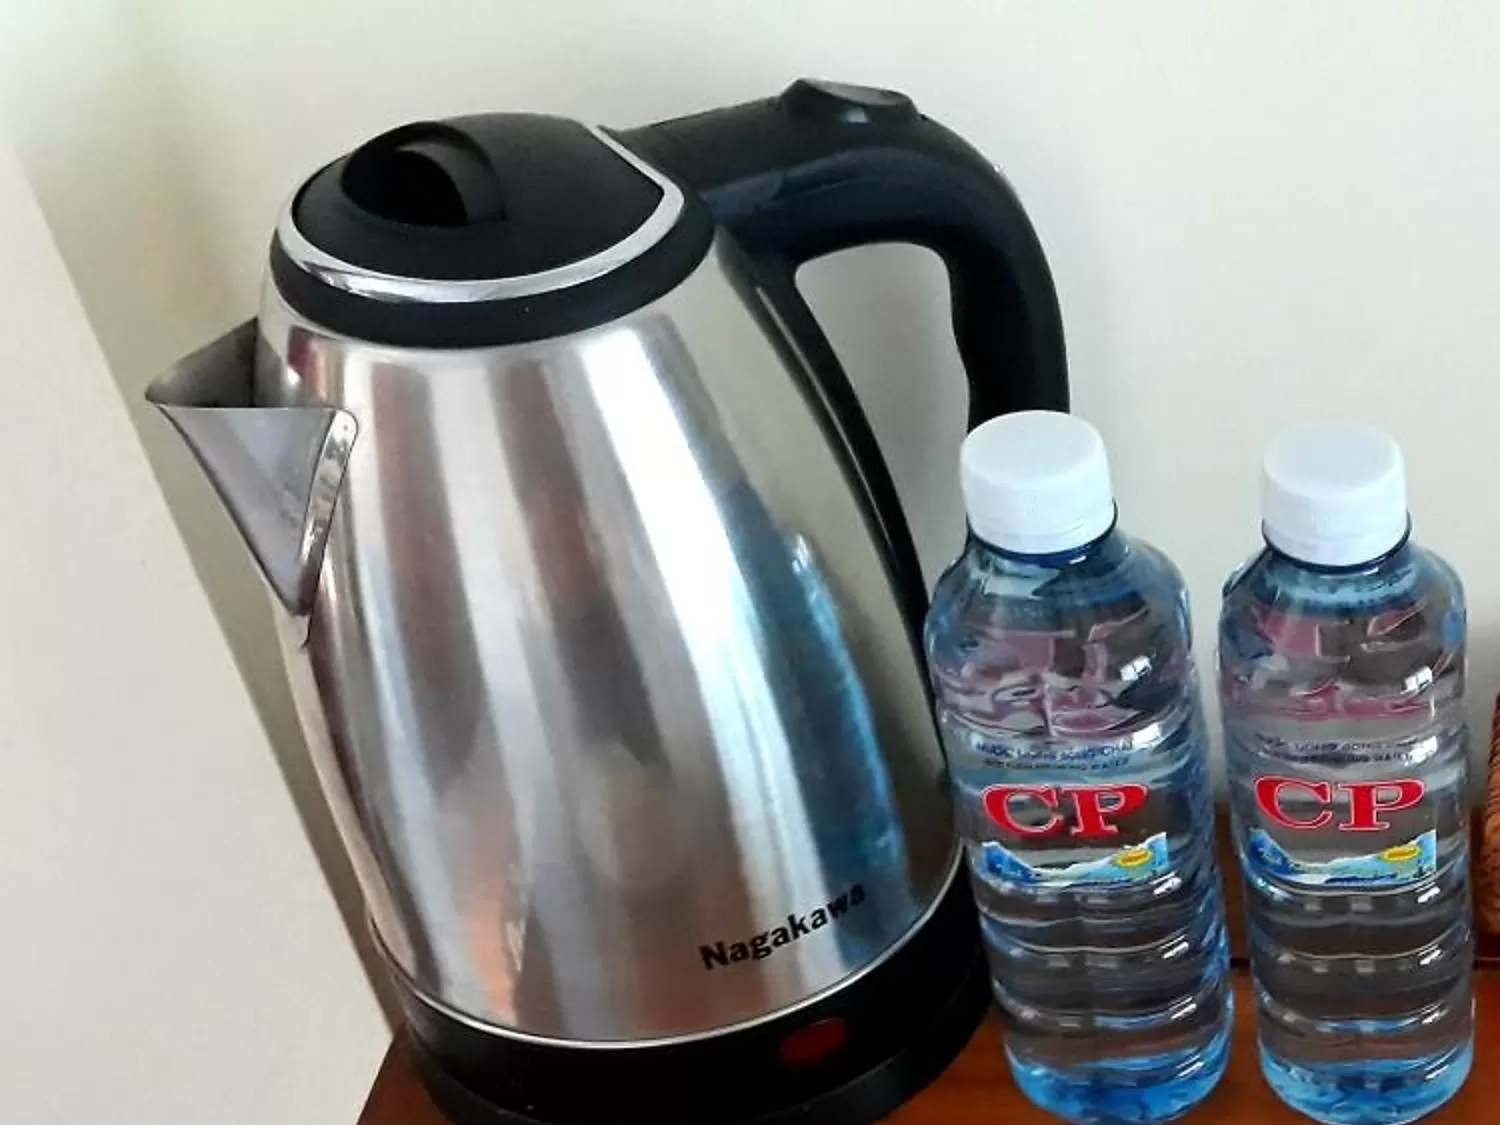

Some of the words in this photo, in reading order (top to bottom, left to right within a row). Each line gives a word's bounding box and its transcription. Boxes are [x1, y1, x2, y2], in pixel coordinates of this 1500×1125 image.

[981, 783, 1148, 837] CP
[1254, 775, 1426, 831] CP
[699, 884, 866, 971] Nagakawa
